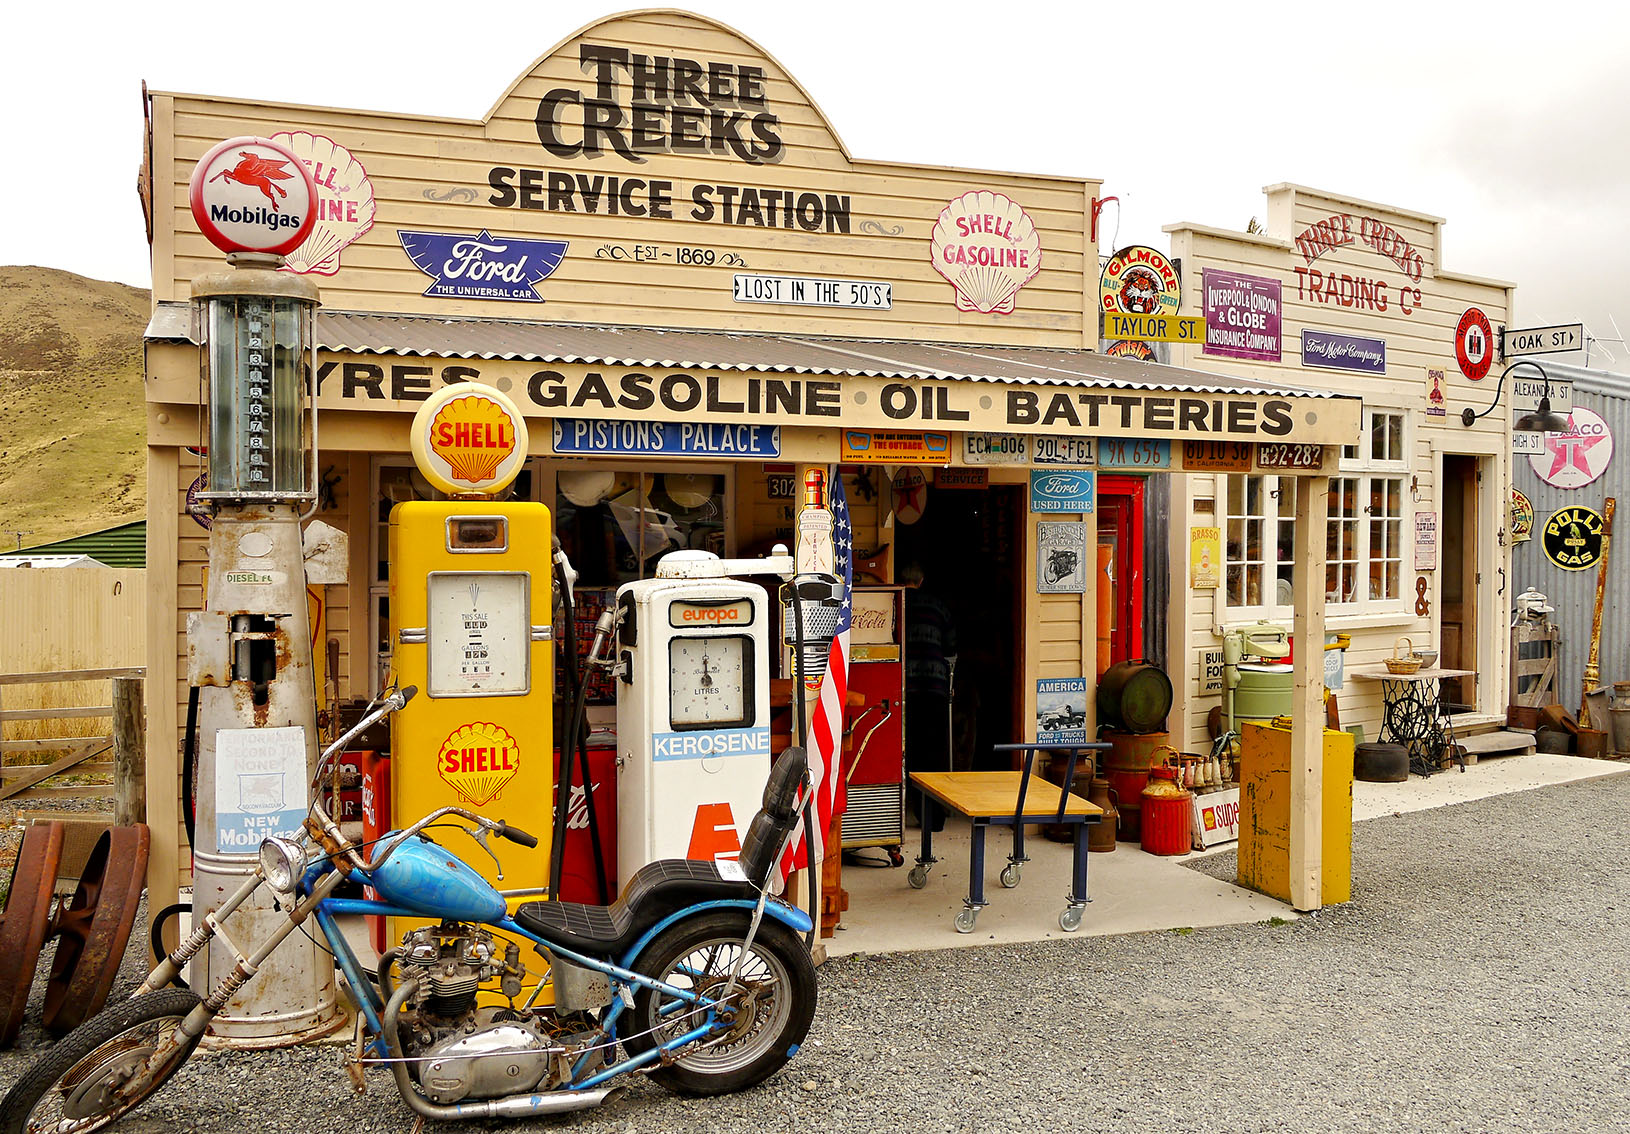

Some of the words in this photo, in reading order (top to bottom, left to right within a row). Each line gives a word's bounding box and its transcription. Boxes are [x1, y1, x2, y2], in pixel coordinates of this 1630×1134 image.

[580, 44, 768, 110] THREE
[535, 88, 783, 164] CREEKS
[488, 167, 672, 218] SERVICE
[691, 184, 851, 234] STATION
[211, 204, 300, 230] Mobilgas
[957, 213, 1013, 241] SHELL
[677, 247, 715, 266] 1869
[943, 244, 1029, 269] GASOLINE
[1295, 214, 1355, 266] THREE
[1360, 216, 1424, 284] CREEKS
[443, 241, 528, 283] Ford
[1109, 250, 1177, 292] GILMORE
[436, 285, 455, 294] THE
[457, 287, 510, 297] UNIVERSAL
[513, 289, 531, 298] CAR
[745, 278, 781, 300] LOST
[791, 282, 804, 301] IN
[815, 283, 840, 303] THE
[850, 285, 882, 305] 50'S
[1234, 281, 1252, 289] THE
[1293, 266, 1387, 312] TRADING
[1208, 286, 1246, 312] LIVERPOOL
[1250, 290, 1277, 316] LONDON
[1227, 307, 1266, 329] GLOBE
[1112, 317, 1166, 337] TAYLOR
[1178, 320, 1197, 339] ST.
[1208, 324, 1245, 347] INSURANCE
[252, 339, 259, 347] 2
[1518, 334, 1543, 349] OAK
[1552, 331, 1566, 346] ST
[252, 356, 260, 364] 3
[1306, 338, 1326, 353] Ford
[1322, 341, 1347, 358] Motor
[1346, 342, 1383, 365] Company
[252, 389, 260, 397] 5
[1560, 386, 1568, 399] ST
[253, 405, 260, 413] 6
[527, 369, 841, 417] GASOLINE
[879, 383, 969, 422] OIL
[1006, 390, 1293, 436] BATTERIES
[253, 423, 260, 431] 7
[438, 422, 509, 449] SHELL
[575, 419, 664, 449] PISTONS
[682, 422, 761, 452] PALACE
[253, 439, 260, 447] 8
[873, 441, 887, 449] THE
[888, 441, 922, 450] OUTBACK
[1000, 437, 1024, 454] 006
[1068, 440, 1093, 459] FG1
[1512, 435, 1527, 448] HIGH
[1531, 435, 1539, 448] ST
[1108, 440, 1126, 464] 9K
[1133, 441, 1161, 465] 656
[252, 471, 261, 480] 10
[1045, 477, 1080, 494] Ford
[1033, 500, 1060, 509] USED
[1063, 501, 1091, 510] HERE
[1547, 510, 1603, 536] POLLY
[1192, 529, 1218, 542] BRASSO
[1557, 551, 1593, 564] GAS
[226, 574, 258, 582] DIESEL
[1415, 576, 1429, 616] &
[683, 607, 738, 623] europa
[694, 687, 720, 695] LITRES
[1039, 682, 1085, 692] AMERICA
[654, 732, 769, 757] KEROSENE
[444, 747, 513, 773] SHELL
[244, 816, 280, 827] NEW
